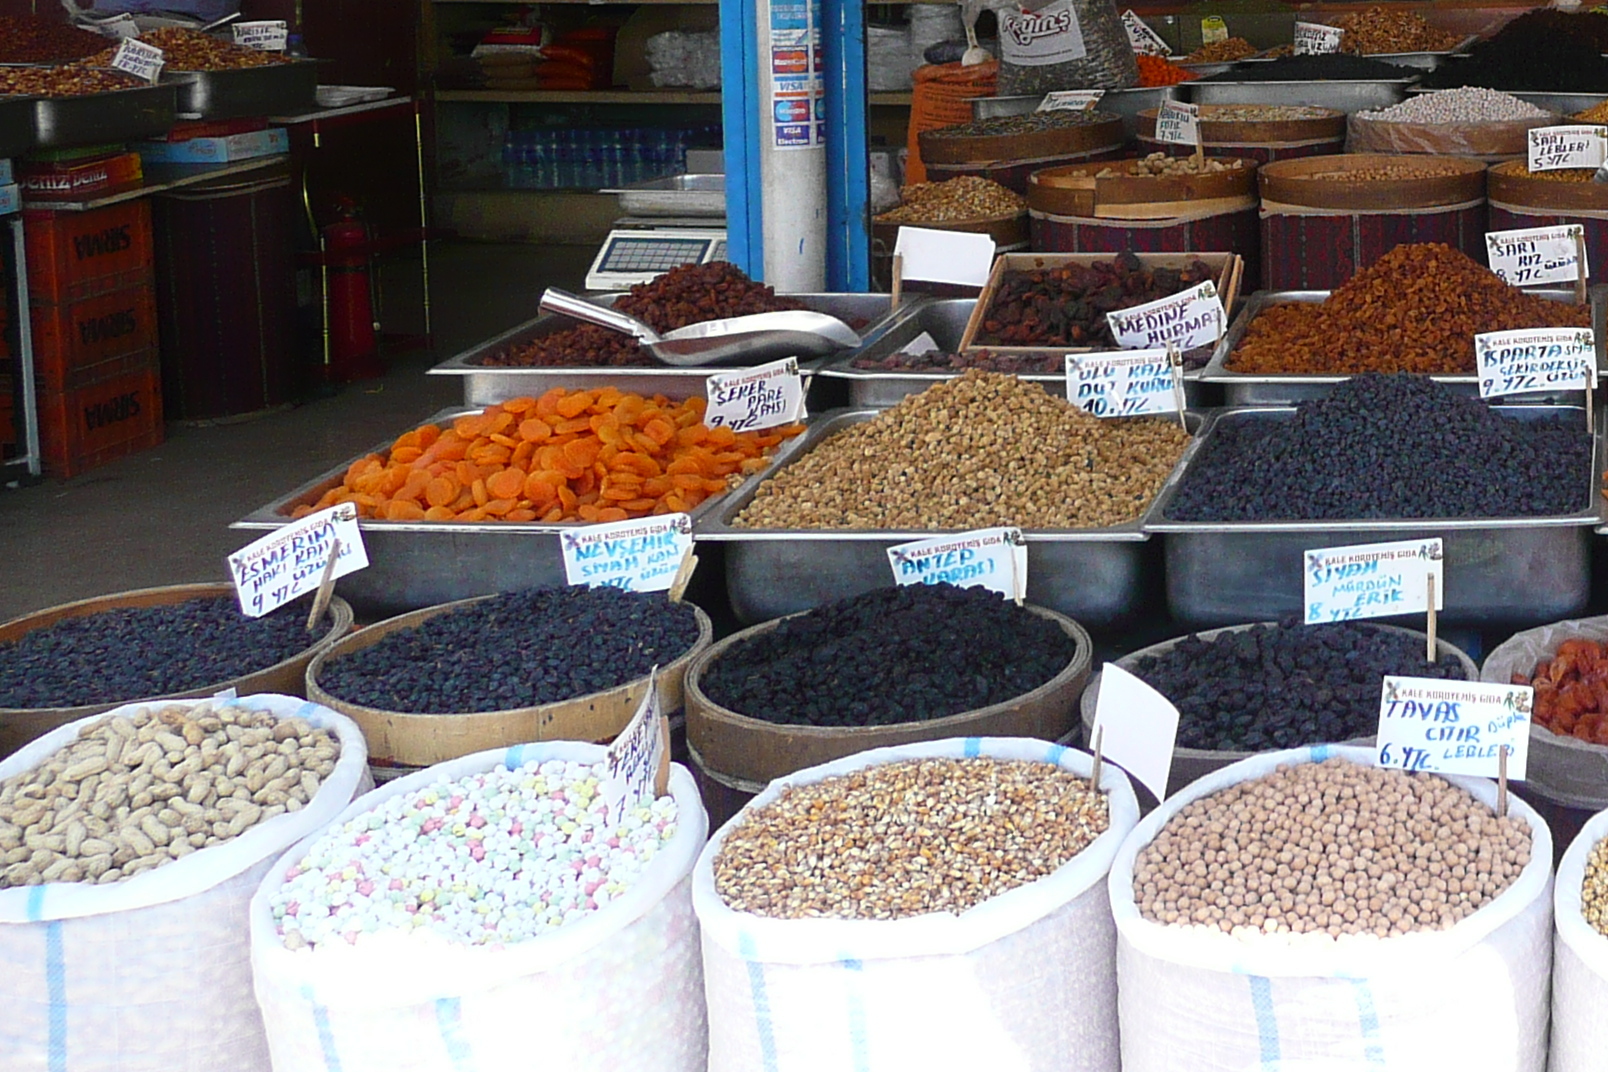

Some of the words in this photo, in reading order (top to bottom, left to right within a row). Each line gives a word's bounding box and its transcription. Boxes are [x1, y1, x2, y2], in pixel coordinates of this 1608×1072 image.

[779, 82, 803, 91] VISA
[1533, 136, 1564, 148] SARI
[1496, 242, 1536, 257] SARI
[1484, 344, 1562, 367] ISPARTA
[902, 550, 975, 575] ANTEP
[1308, 602, 1322, 620] 8
